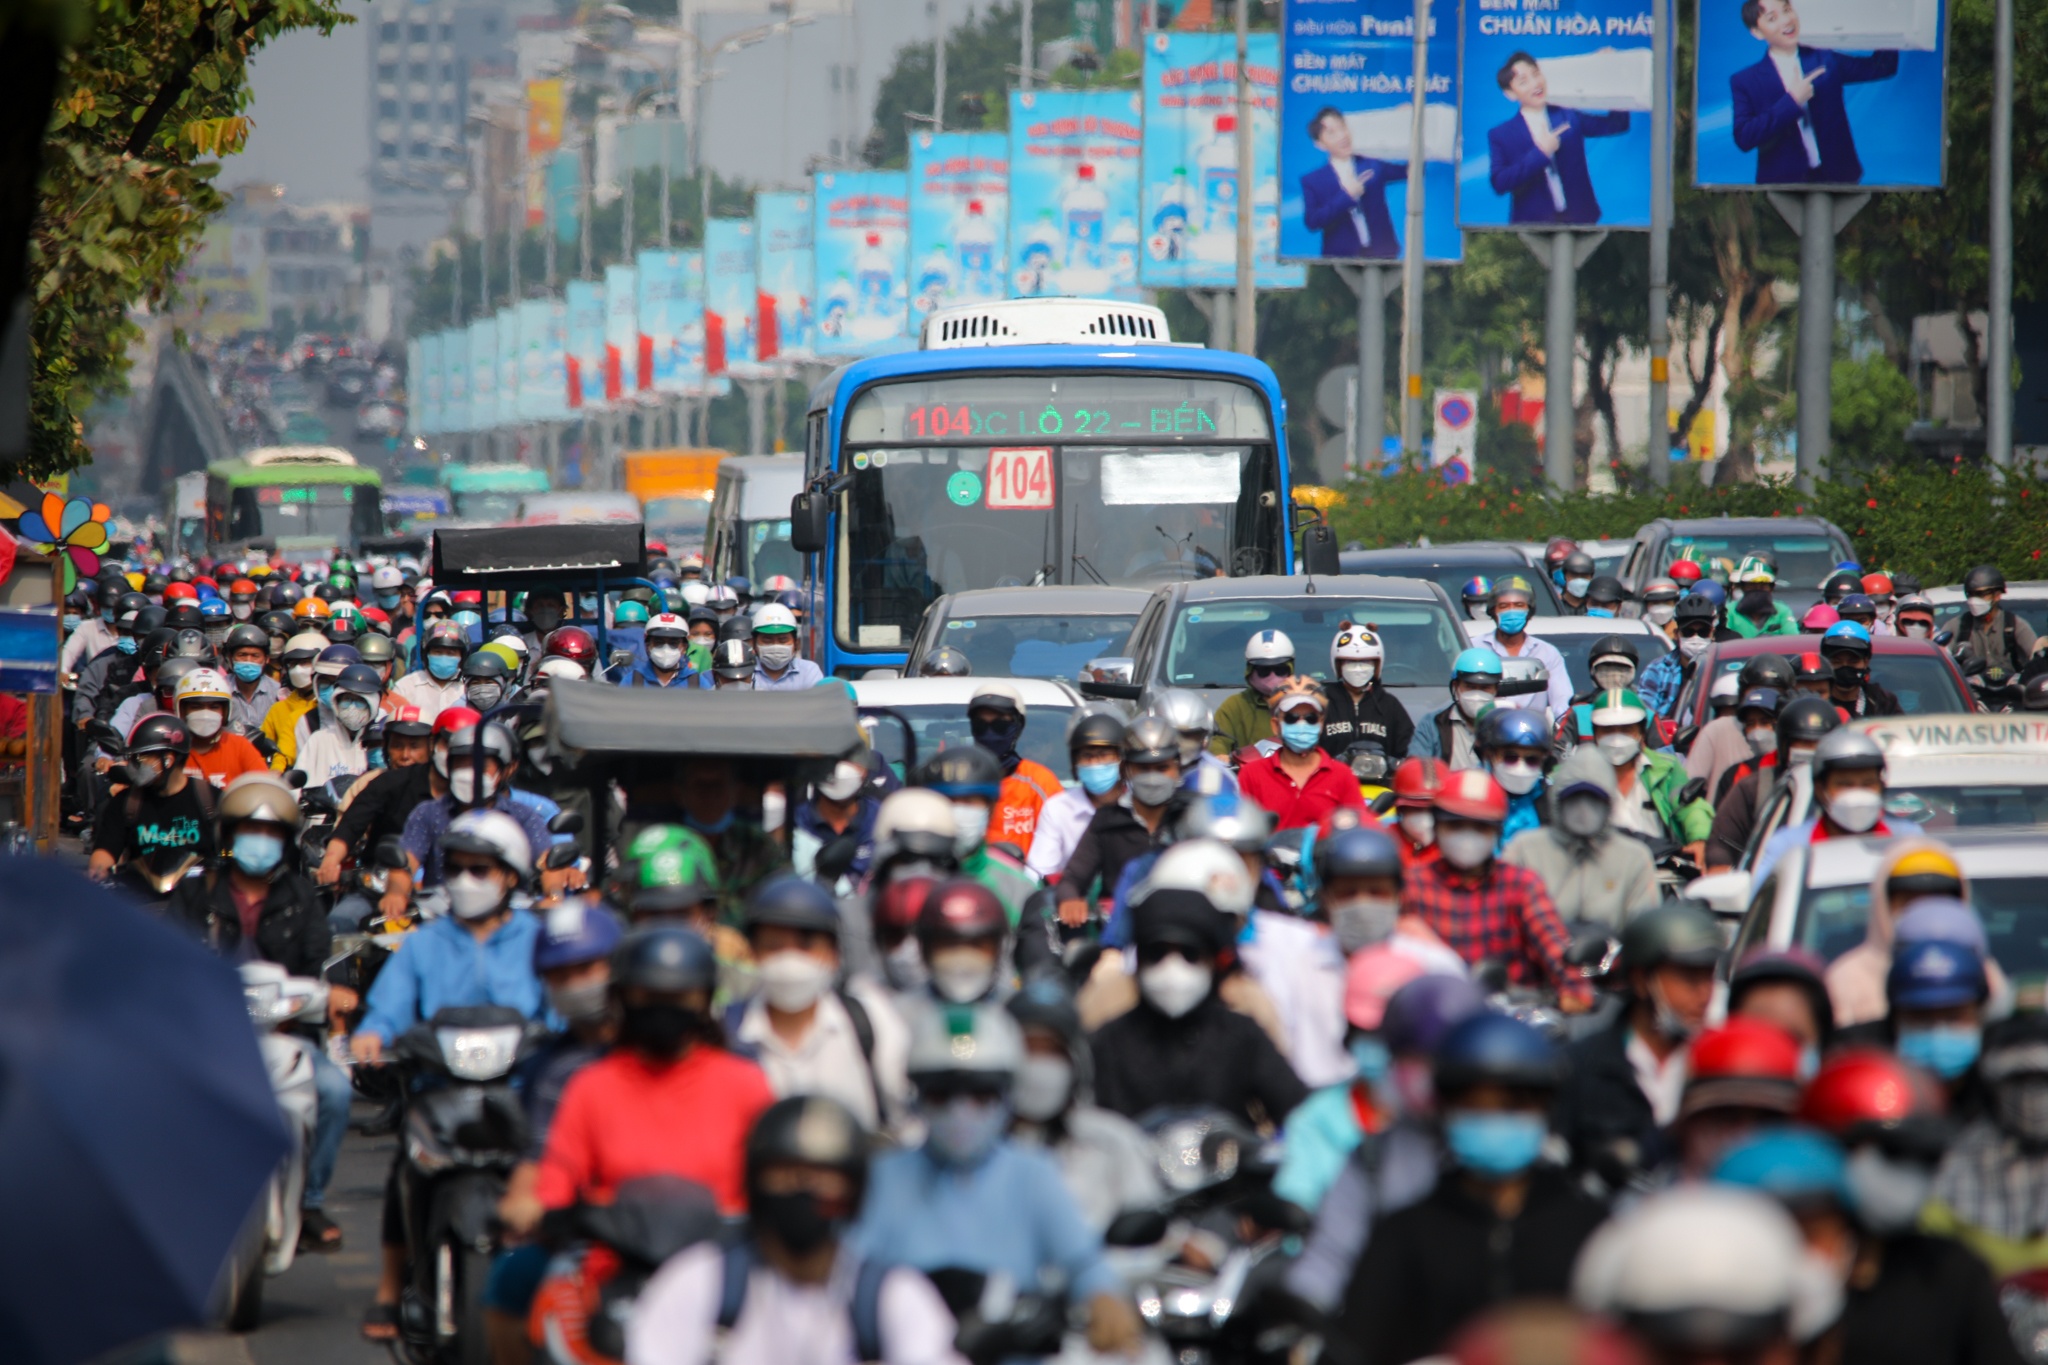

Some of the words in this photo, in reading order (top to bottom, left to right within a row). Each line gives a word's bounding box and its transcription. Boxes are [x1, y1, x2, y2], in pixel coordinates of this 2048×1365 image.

[1361, 14, 1437, 37] Funii
[1555, 12, 1601, 35] HÒA
[1361, 71, 1403, 93] HÒA
[910, 406, 970, 436] 104
[1074, 409, 1111, 434] 22
[994, 456, 1047, 500] 104
[1907, 723, 2027, 745] VINASUN
